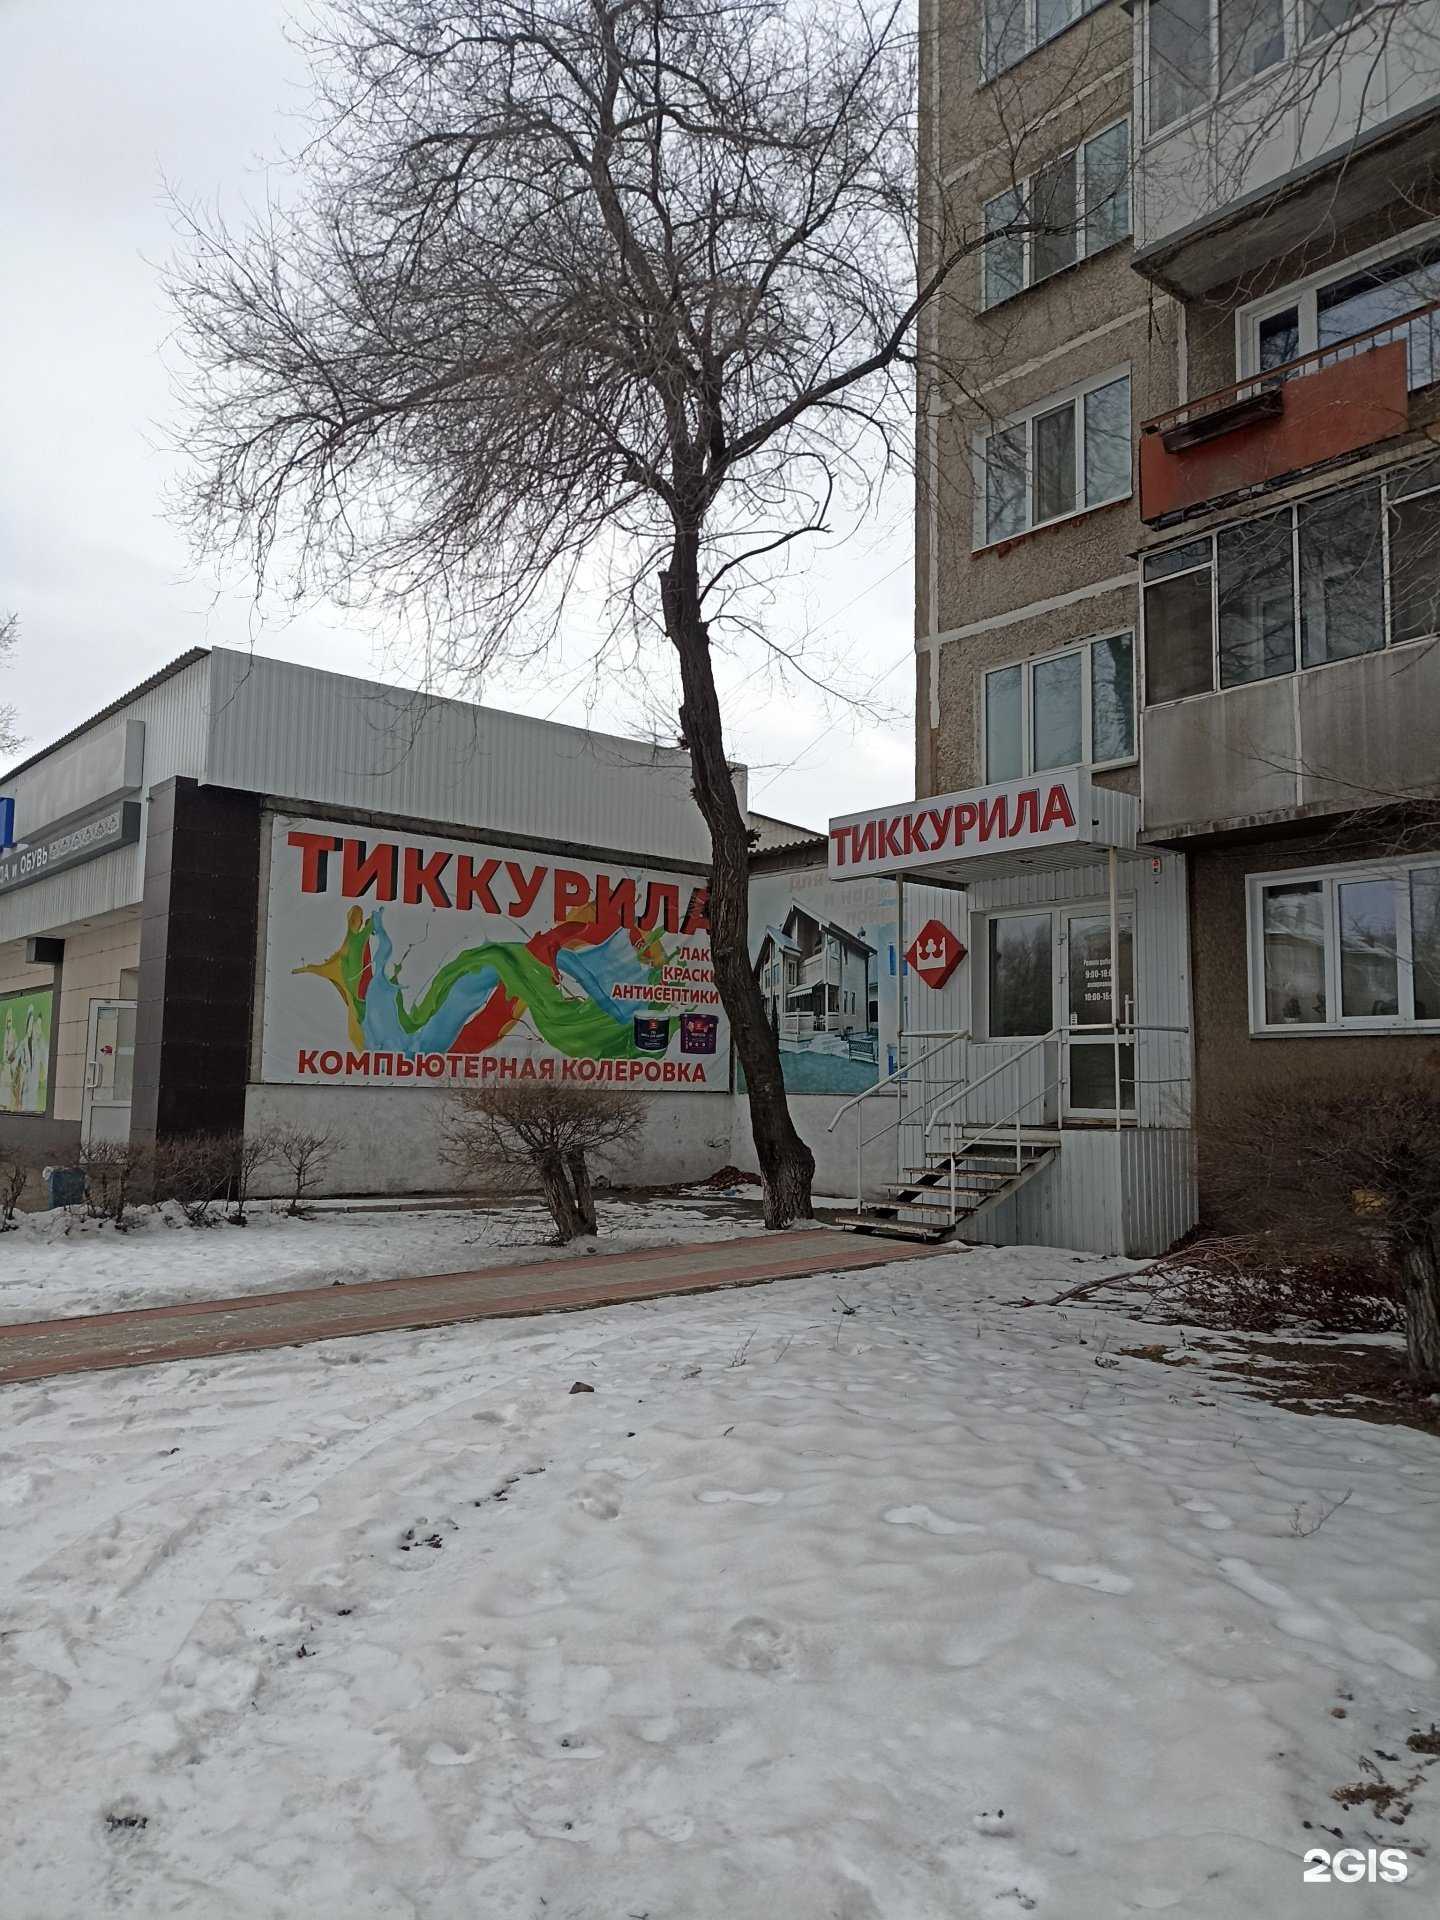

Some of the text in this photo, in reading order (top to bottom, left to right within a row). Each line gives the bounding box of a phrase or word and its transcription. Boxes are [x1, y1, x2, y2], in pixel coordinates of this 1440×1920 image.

[830, 784, 1076, 866] ТИККУРИЛА
[20, 847, 48, 874] ОБУВЬ
[680, 946, 711, 962] ЛАК
[612, 984, 720, 1004] АНТИСЕПТИКИ
[299, 1049, 707, 1083] КОМПЬЮТЕРНАЯ КОЛЕРОВКА
